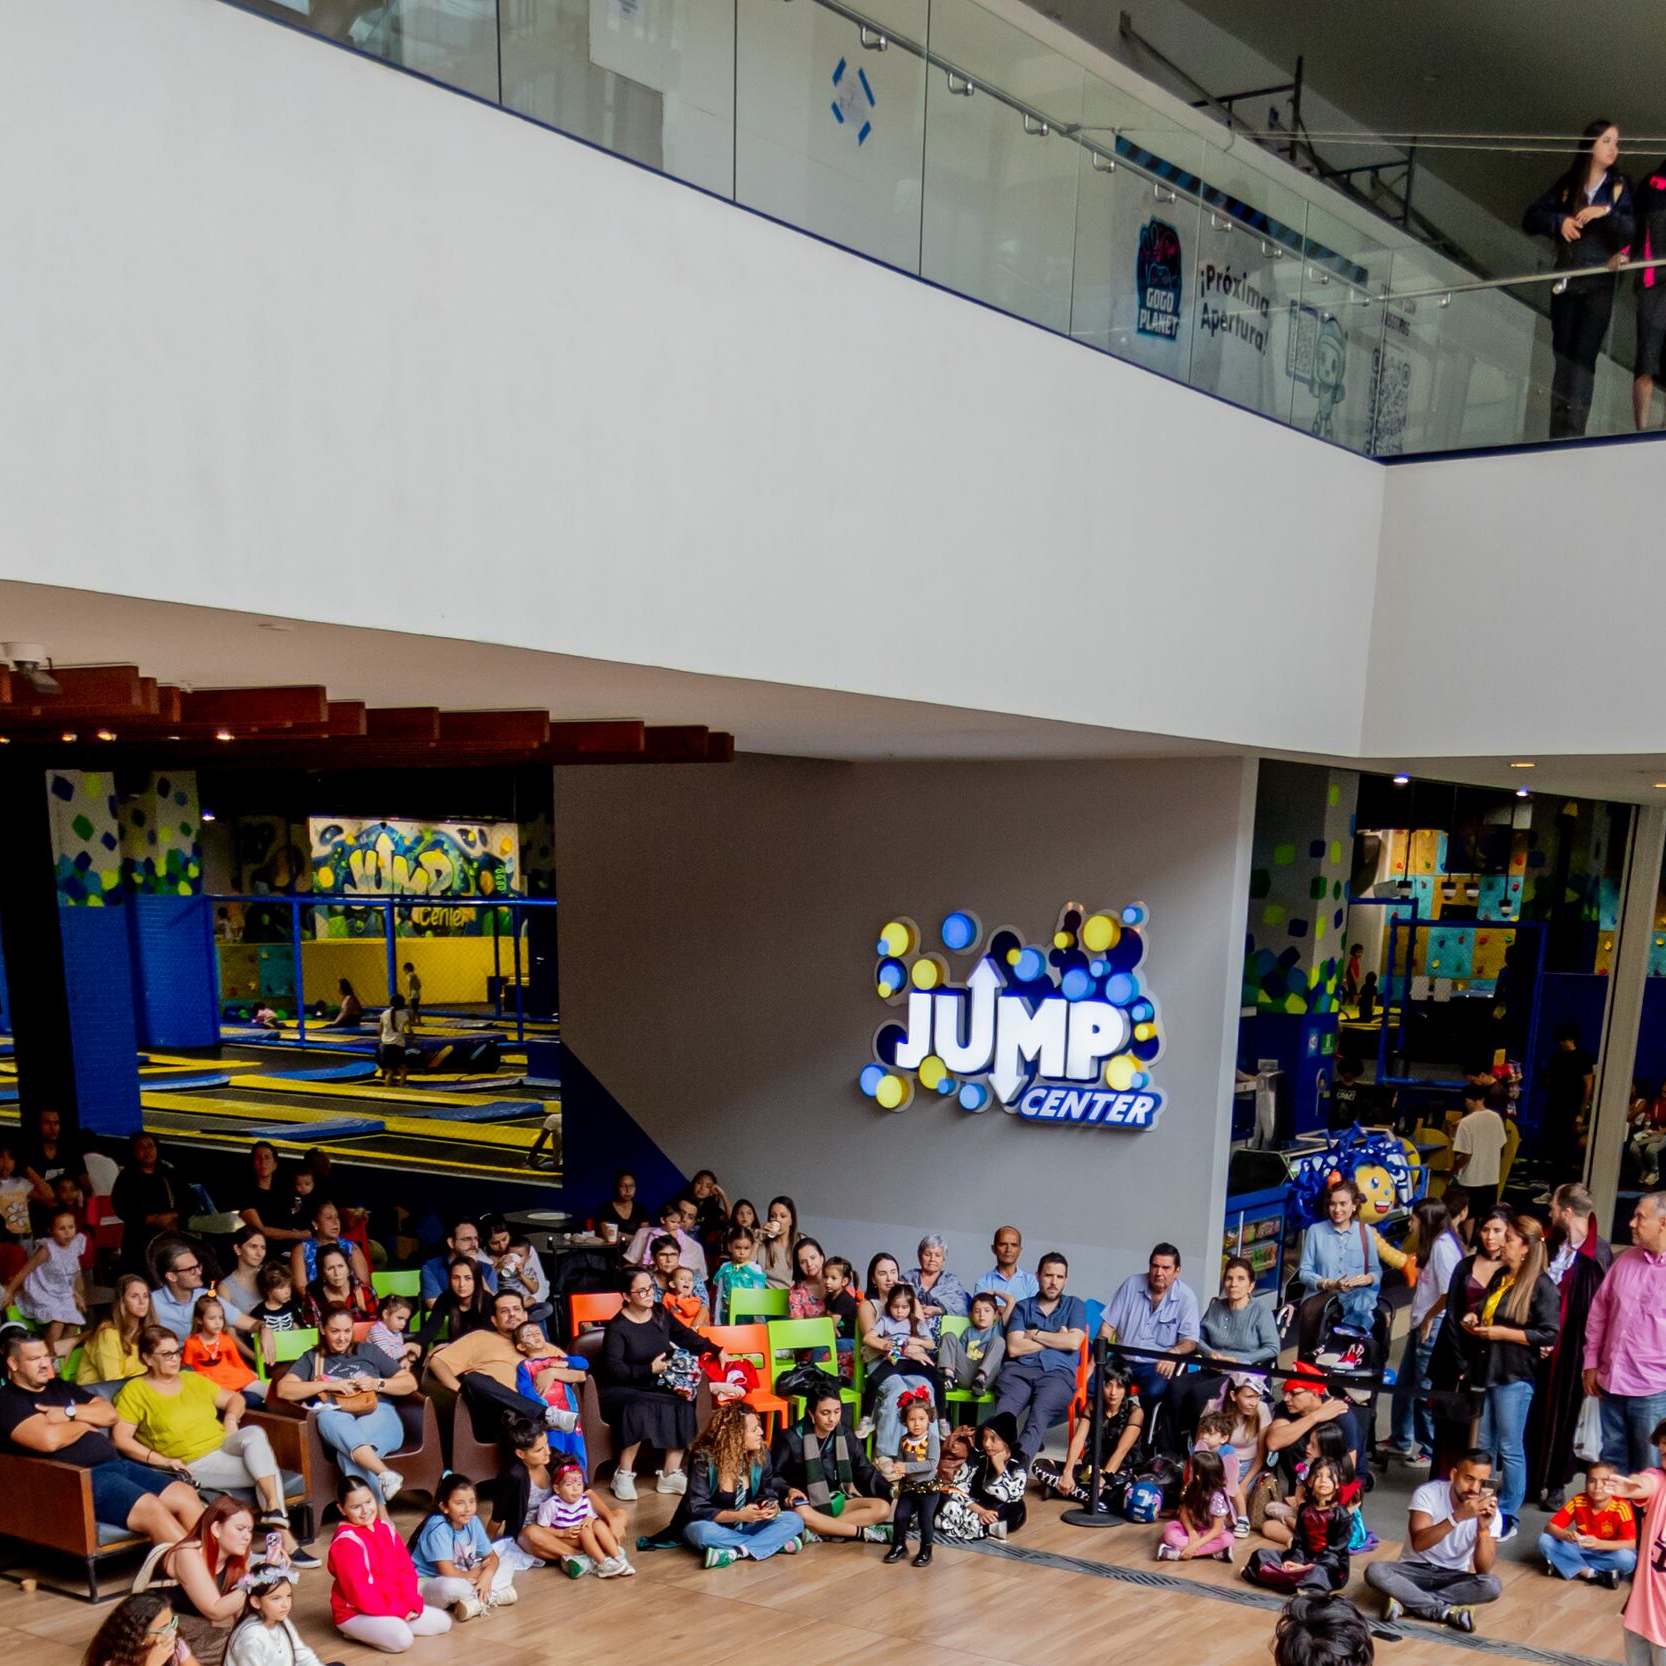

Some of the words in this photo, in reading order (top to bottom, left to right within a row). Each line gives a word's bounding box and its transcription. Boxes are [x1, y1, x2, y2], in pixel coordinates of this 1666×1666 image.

[1146, 287, 1175, 313] GOGO
[1201, 265, 1270, 319] ¡Próxima
[1139, 308, 1180, 337] PLANET
[1200, 302, 1269, 357] Apertura!
[895, 956, 1129, 1104] JUMP
[1019, 1087, 1155, 1125] CENTER
